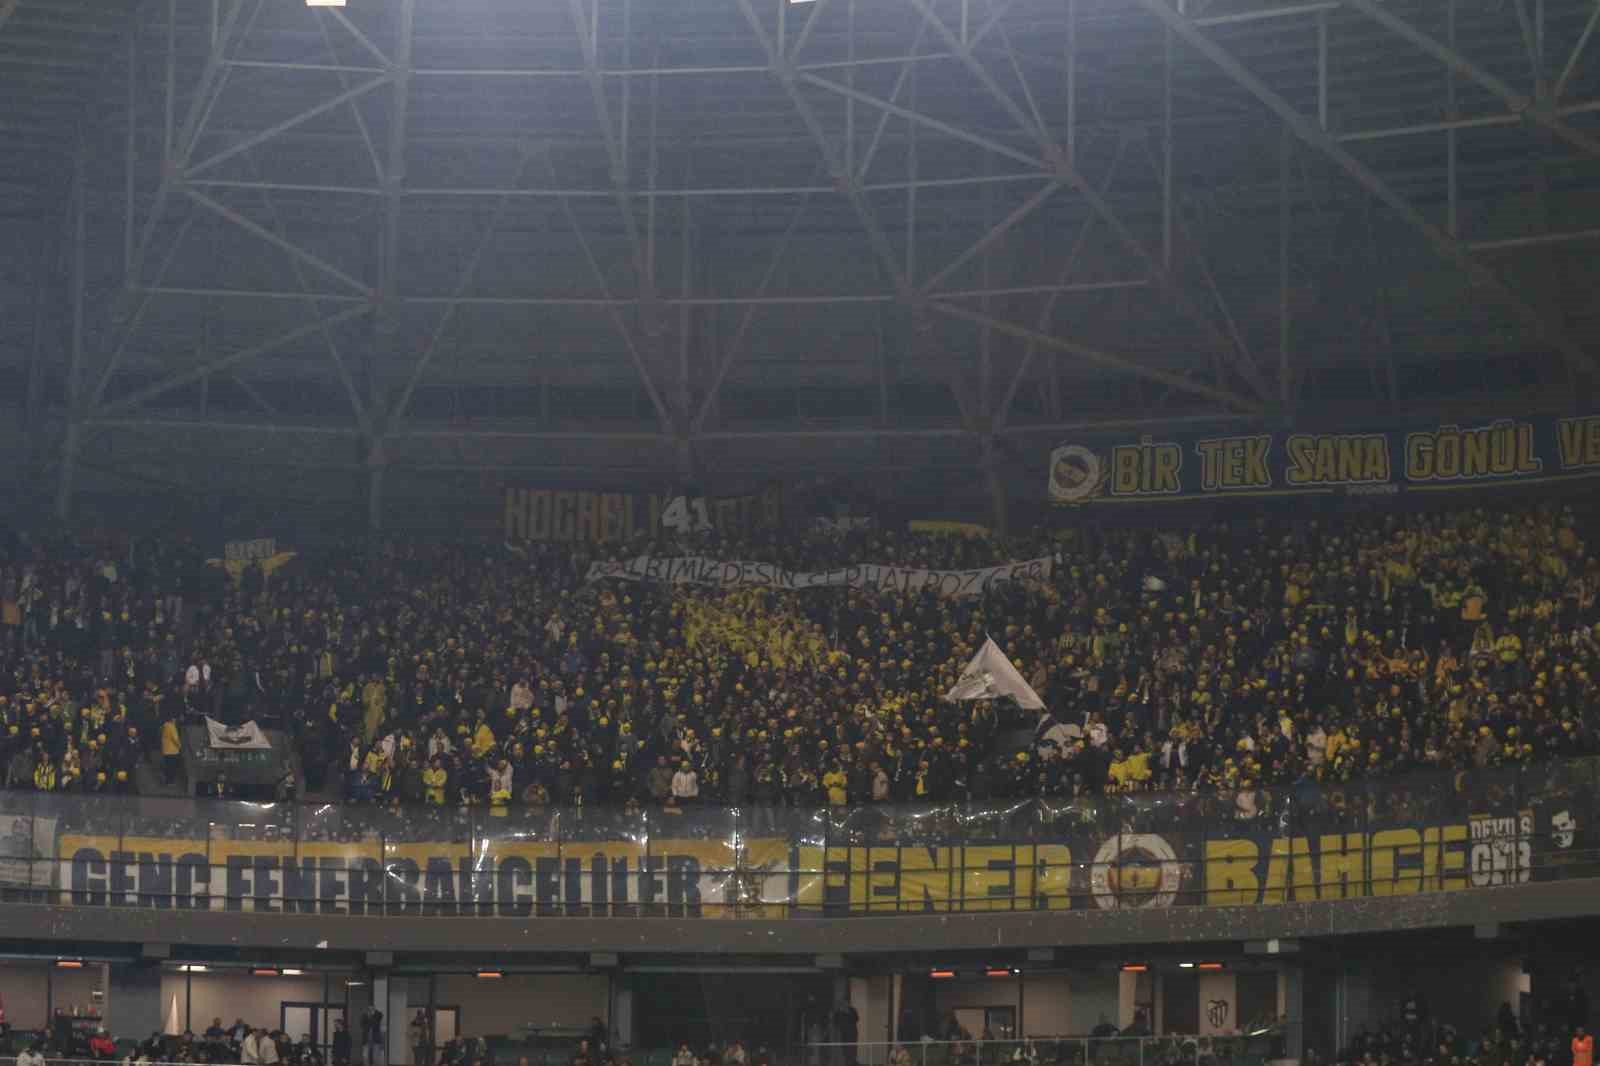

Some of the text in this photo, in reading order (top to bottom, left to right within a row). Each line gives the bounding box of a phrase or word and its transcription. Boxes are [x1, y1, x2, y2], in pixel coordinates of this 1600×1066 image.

[1112, 434, 1182, 494] BİR
[1196, 436, 1269, 490] TEK
[1285, 433, 1389, 484] SANA
[1402, 420, 1543, 481] GÖNÜL
[661, 496, 712, 533] 41
[799, 845, 1071, 912] FENER
